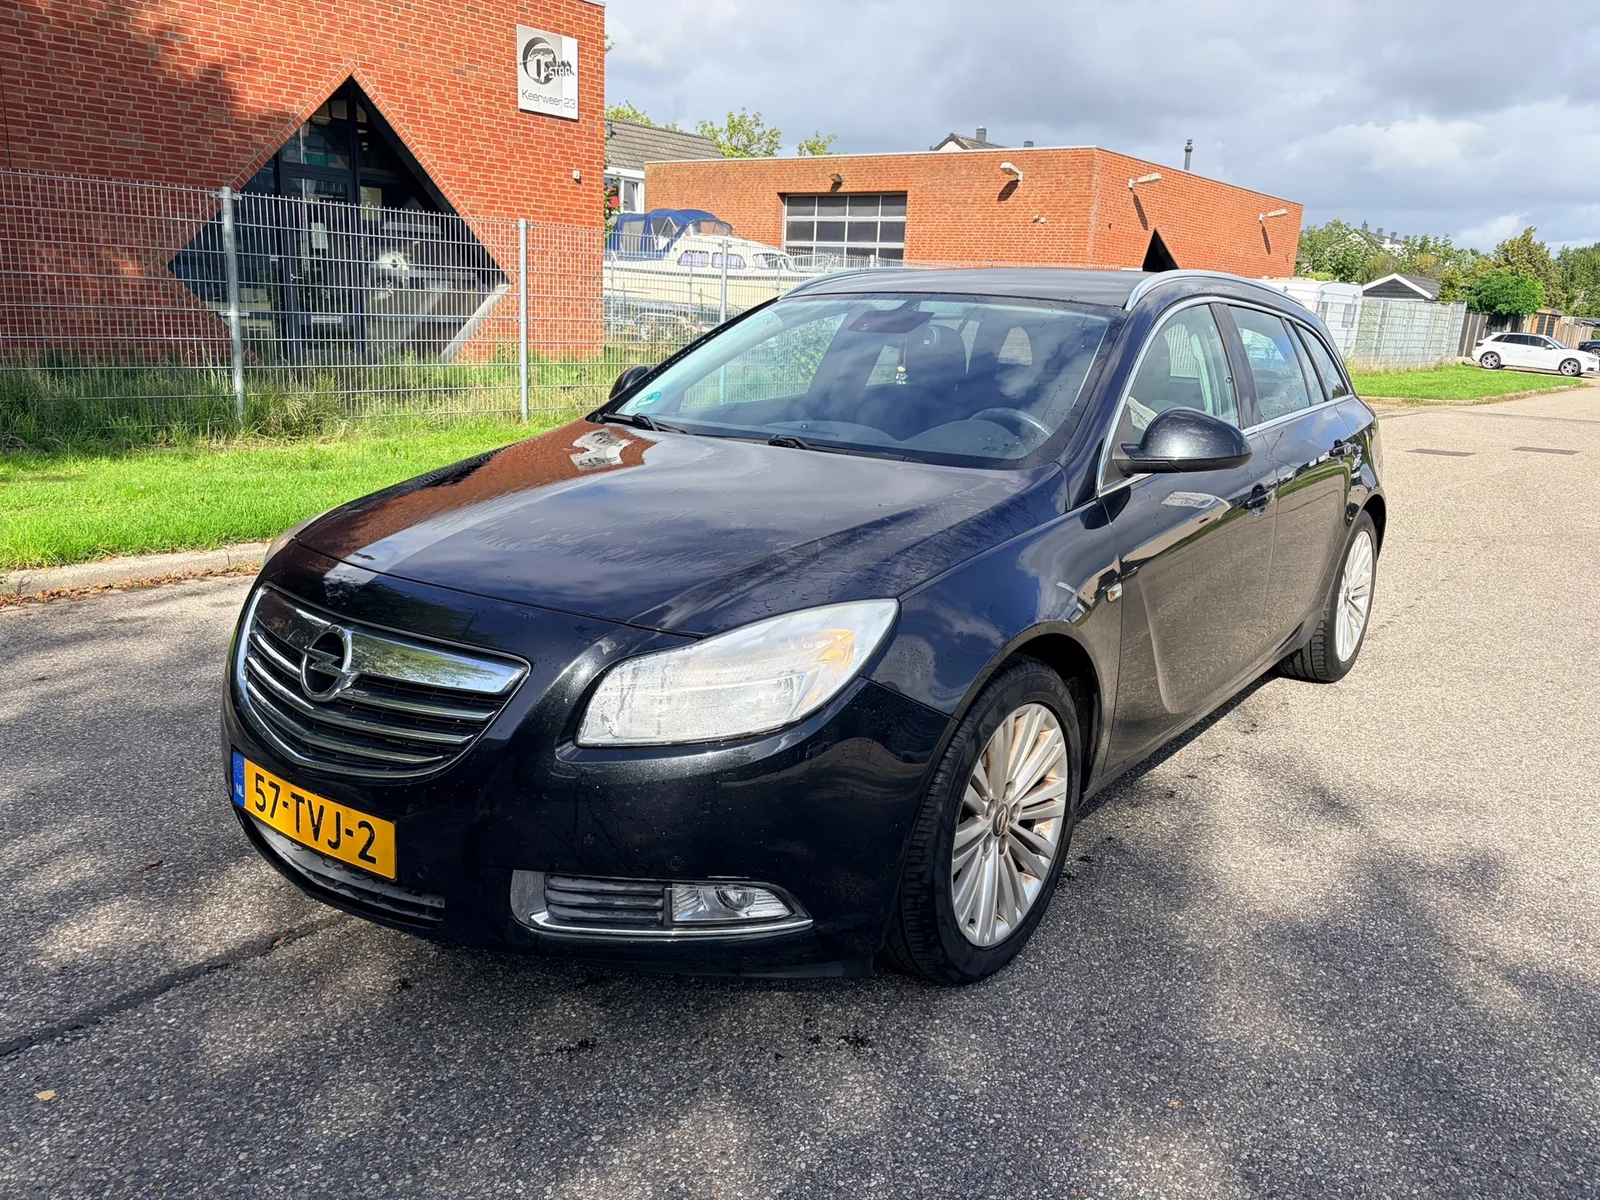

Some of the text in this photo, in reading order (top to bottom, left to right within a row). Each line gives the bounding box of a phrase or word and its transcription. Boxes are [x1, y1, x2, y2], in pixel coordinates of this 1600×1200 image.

[521, 88, 576, 109] Keerweer 23
[235, 772, 377, 865] NL 57-TVJ-2
